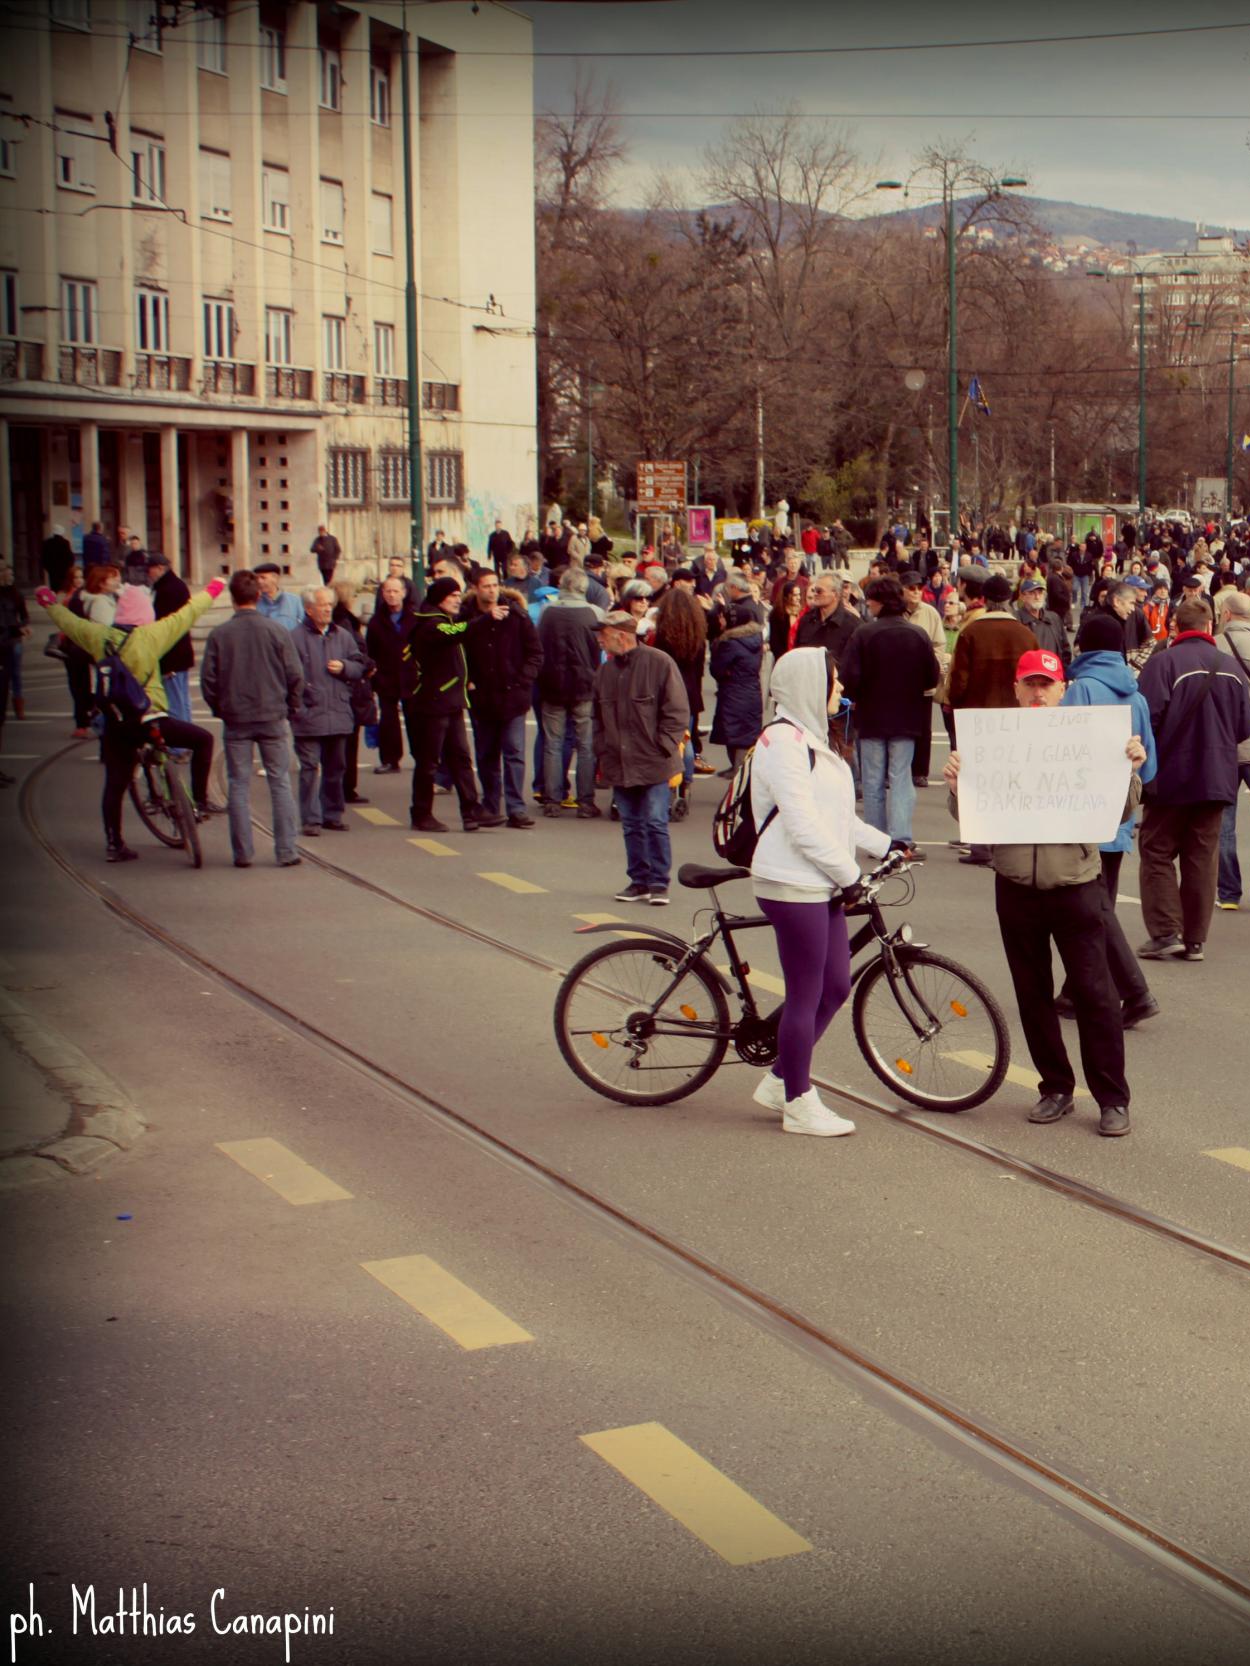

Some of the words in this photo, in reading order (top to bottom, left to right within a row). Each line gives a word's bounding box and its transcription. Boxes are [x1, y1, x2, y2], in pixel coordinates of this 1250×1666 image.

[974, 712, 1020, 736] BOLI
[1042, 743, 1093, 762] GLAVA
[976, 769, 1022, 791] DOK
[1037, 767, 1093, 792] NAS
[976, 791, 1033, 812] BAKIR
